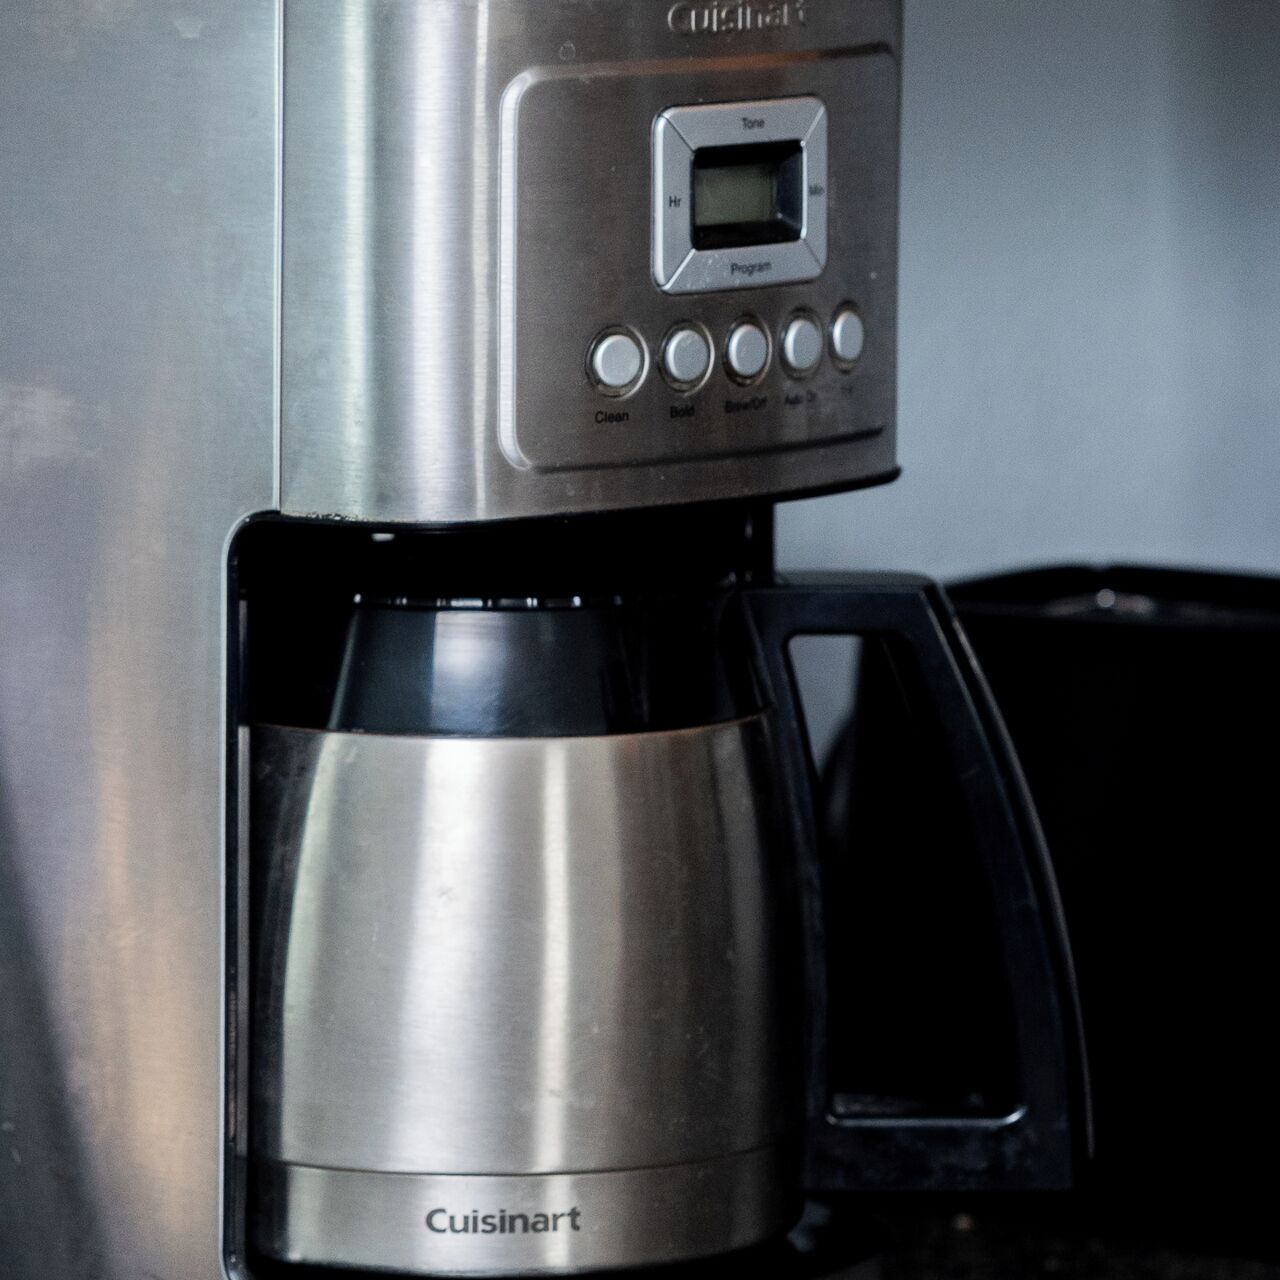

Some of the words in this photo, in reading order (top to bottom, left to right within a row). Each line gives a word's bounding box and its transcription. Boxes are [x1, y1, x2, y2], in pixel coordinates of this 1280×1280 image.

[742, 117, 766, 130] Tone
[669, 195, 682, 208] Hr
[731, 262, 771, 277] Program
[595, 410, 631, 425] Clean
[670, 405, 696, 420] Bold
[425, 1206, 582, 1235] Cuisinart
